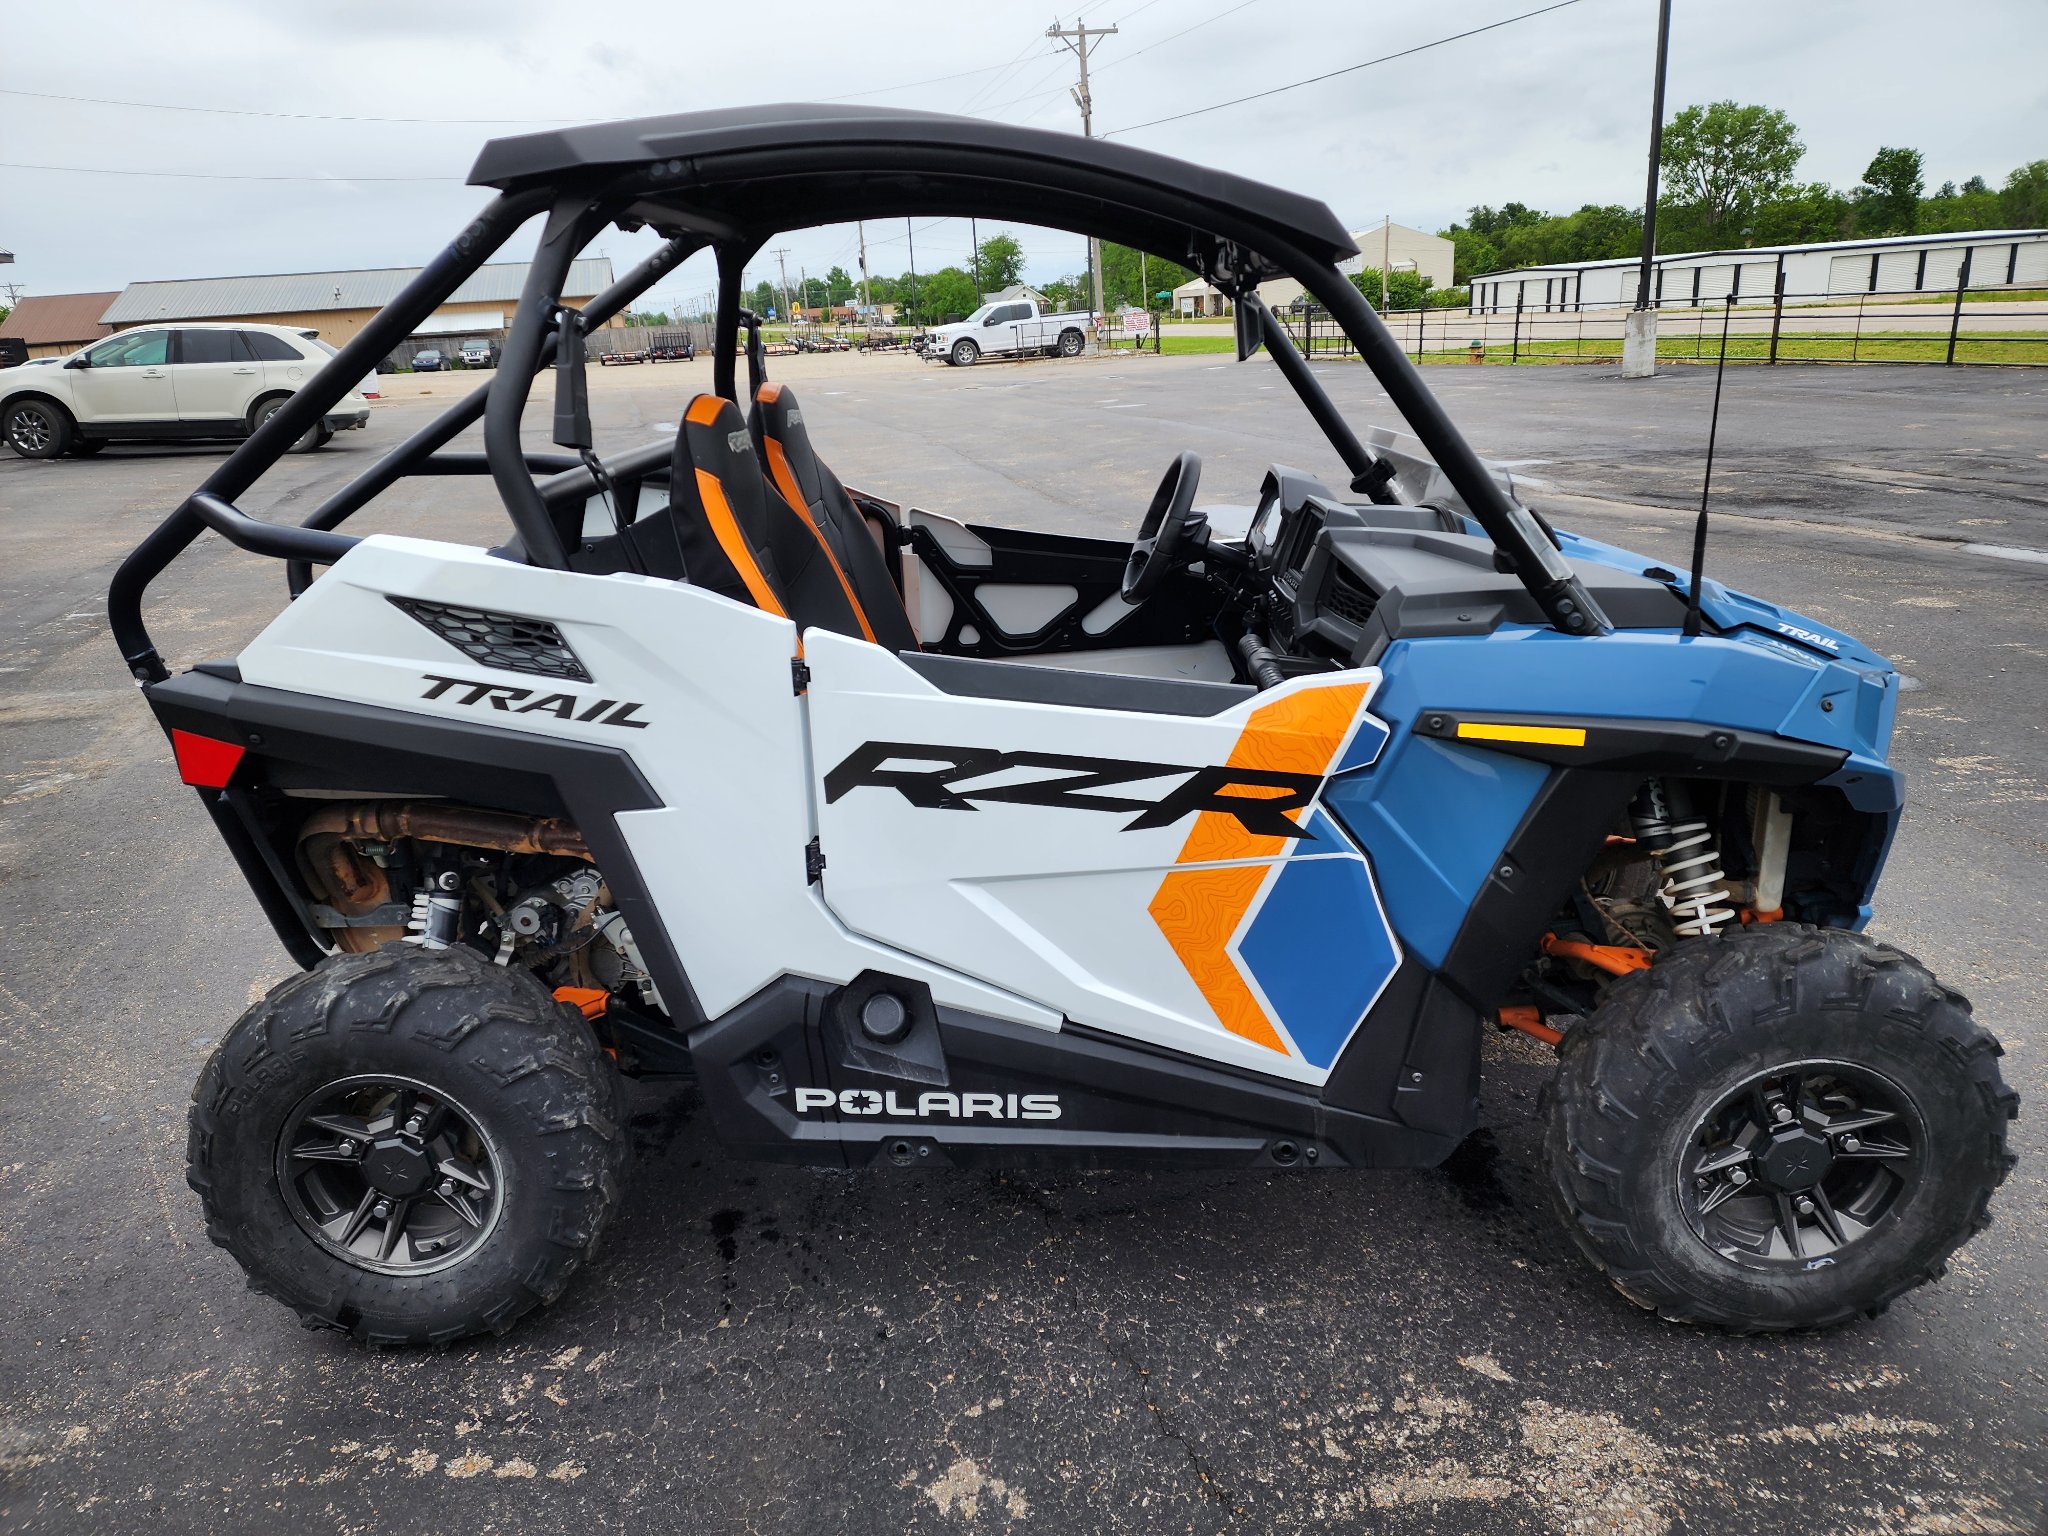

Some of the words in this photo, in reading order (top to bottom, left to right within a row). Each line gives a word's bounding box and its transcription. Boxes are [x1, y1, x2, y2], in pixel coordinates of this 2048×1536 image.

[1777, 622, 1839, 651] TRAIL
[420, 674, 652, 729] TRAIL
[823, 740, 1325, 840] RZR
[795, 1087, 1062, 1120] POLARIS
